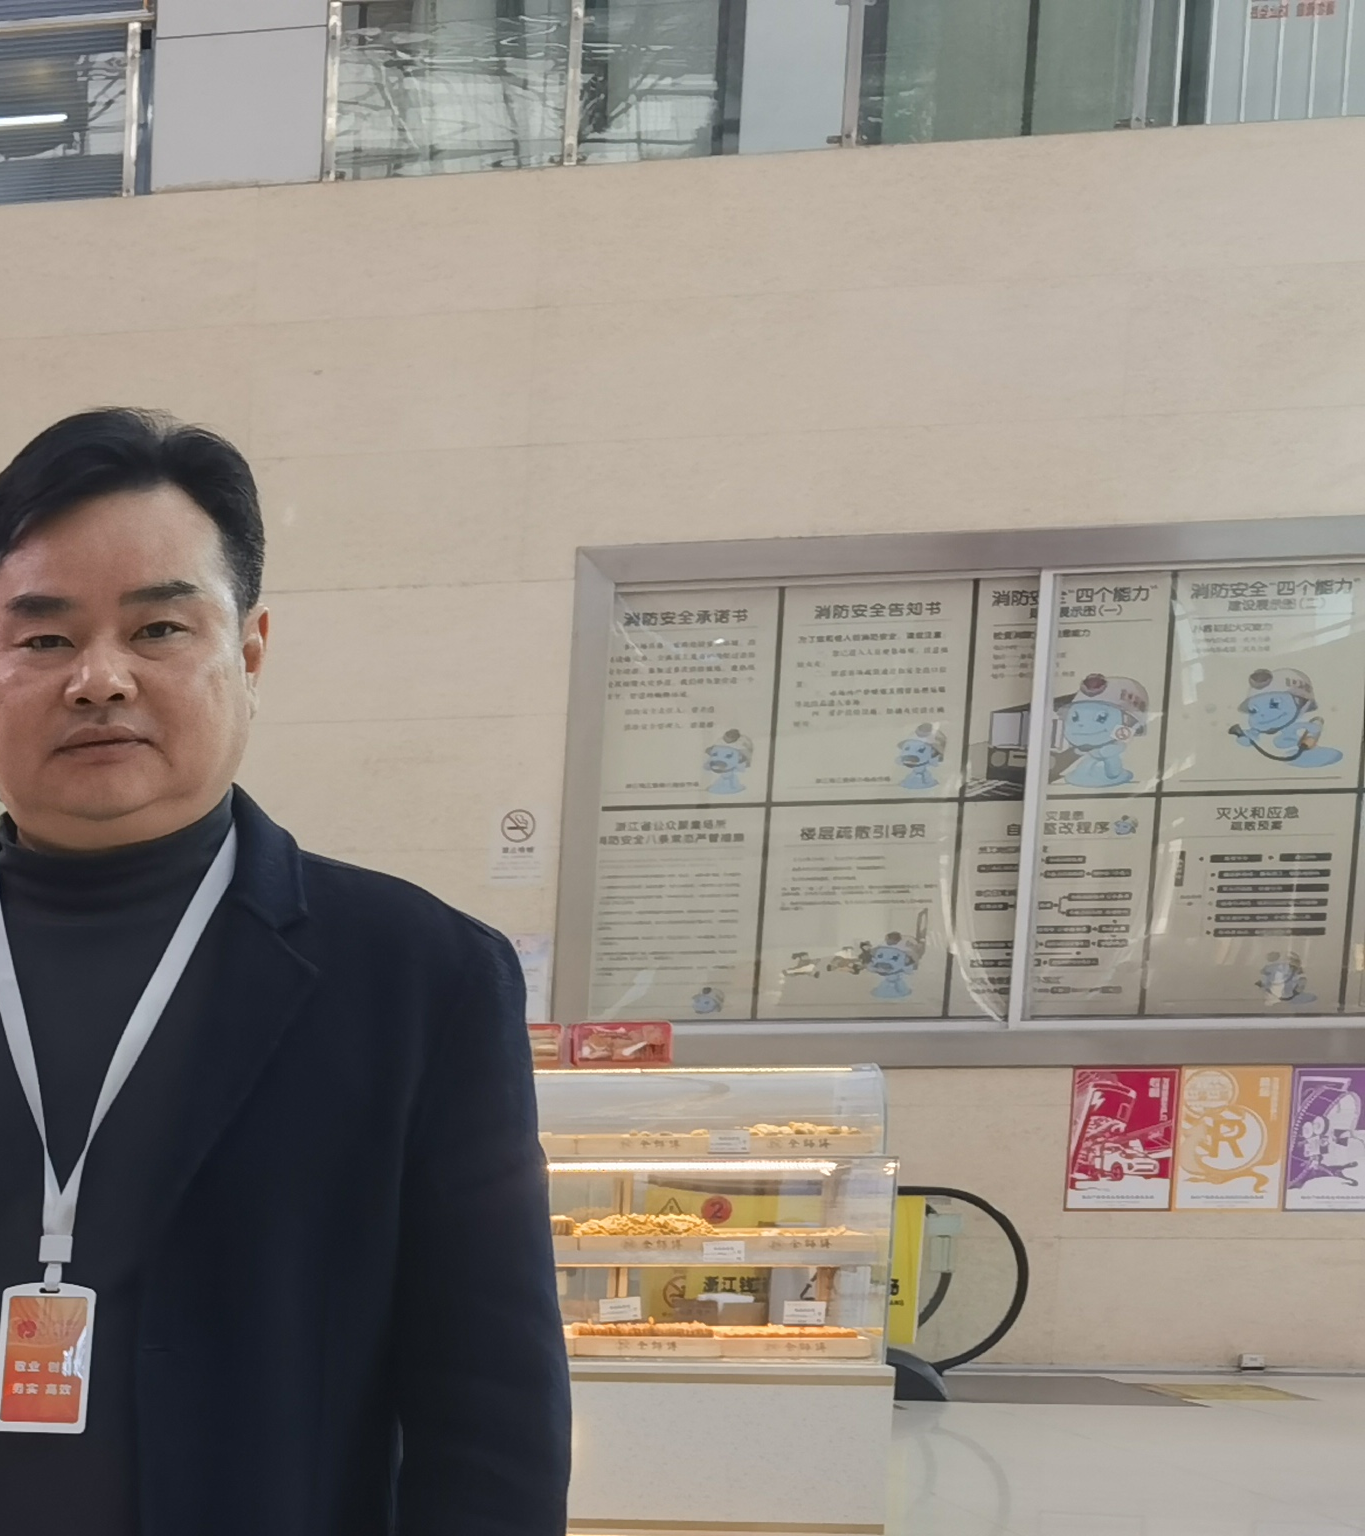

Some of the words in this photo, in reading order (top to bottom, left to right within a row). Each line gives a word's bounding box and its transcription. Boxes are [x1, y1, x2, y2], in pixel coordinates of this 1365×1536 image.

[623, 608, 749, 627] 消防安全承诺书
[814, 601, 942, 620] 消防安全告知书
[1216, 805, 1300, 820] 灭火和应急
[800, 823, 926, 841] 楼层疏散引导员
